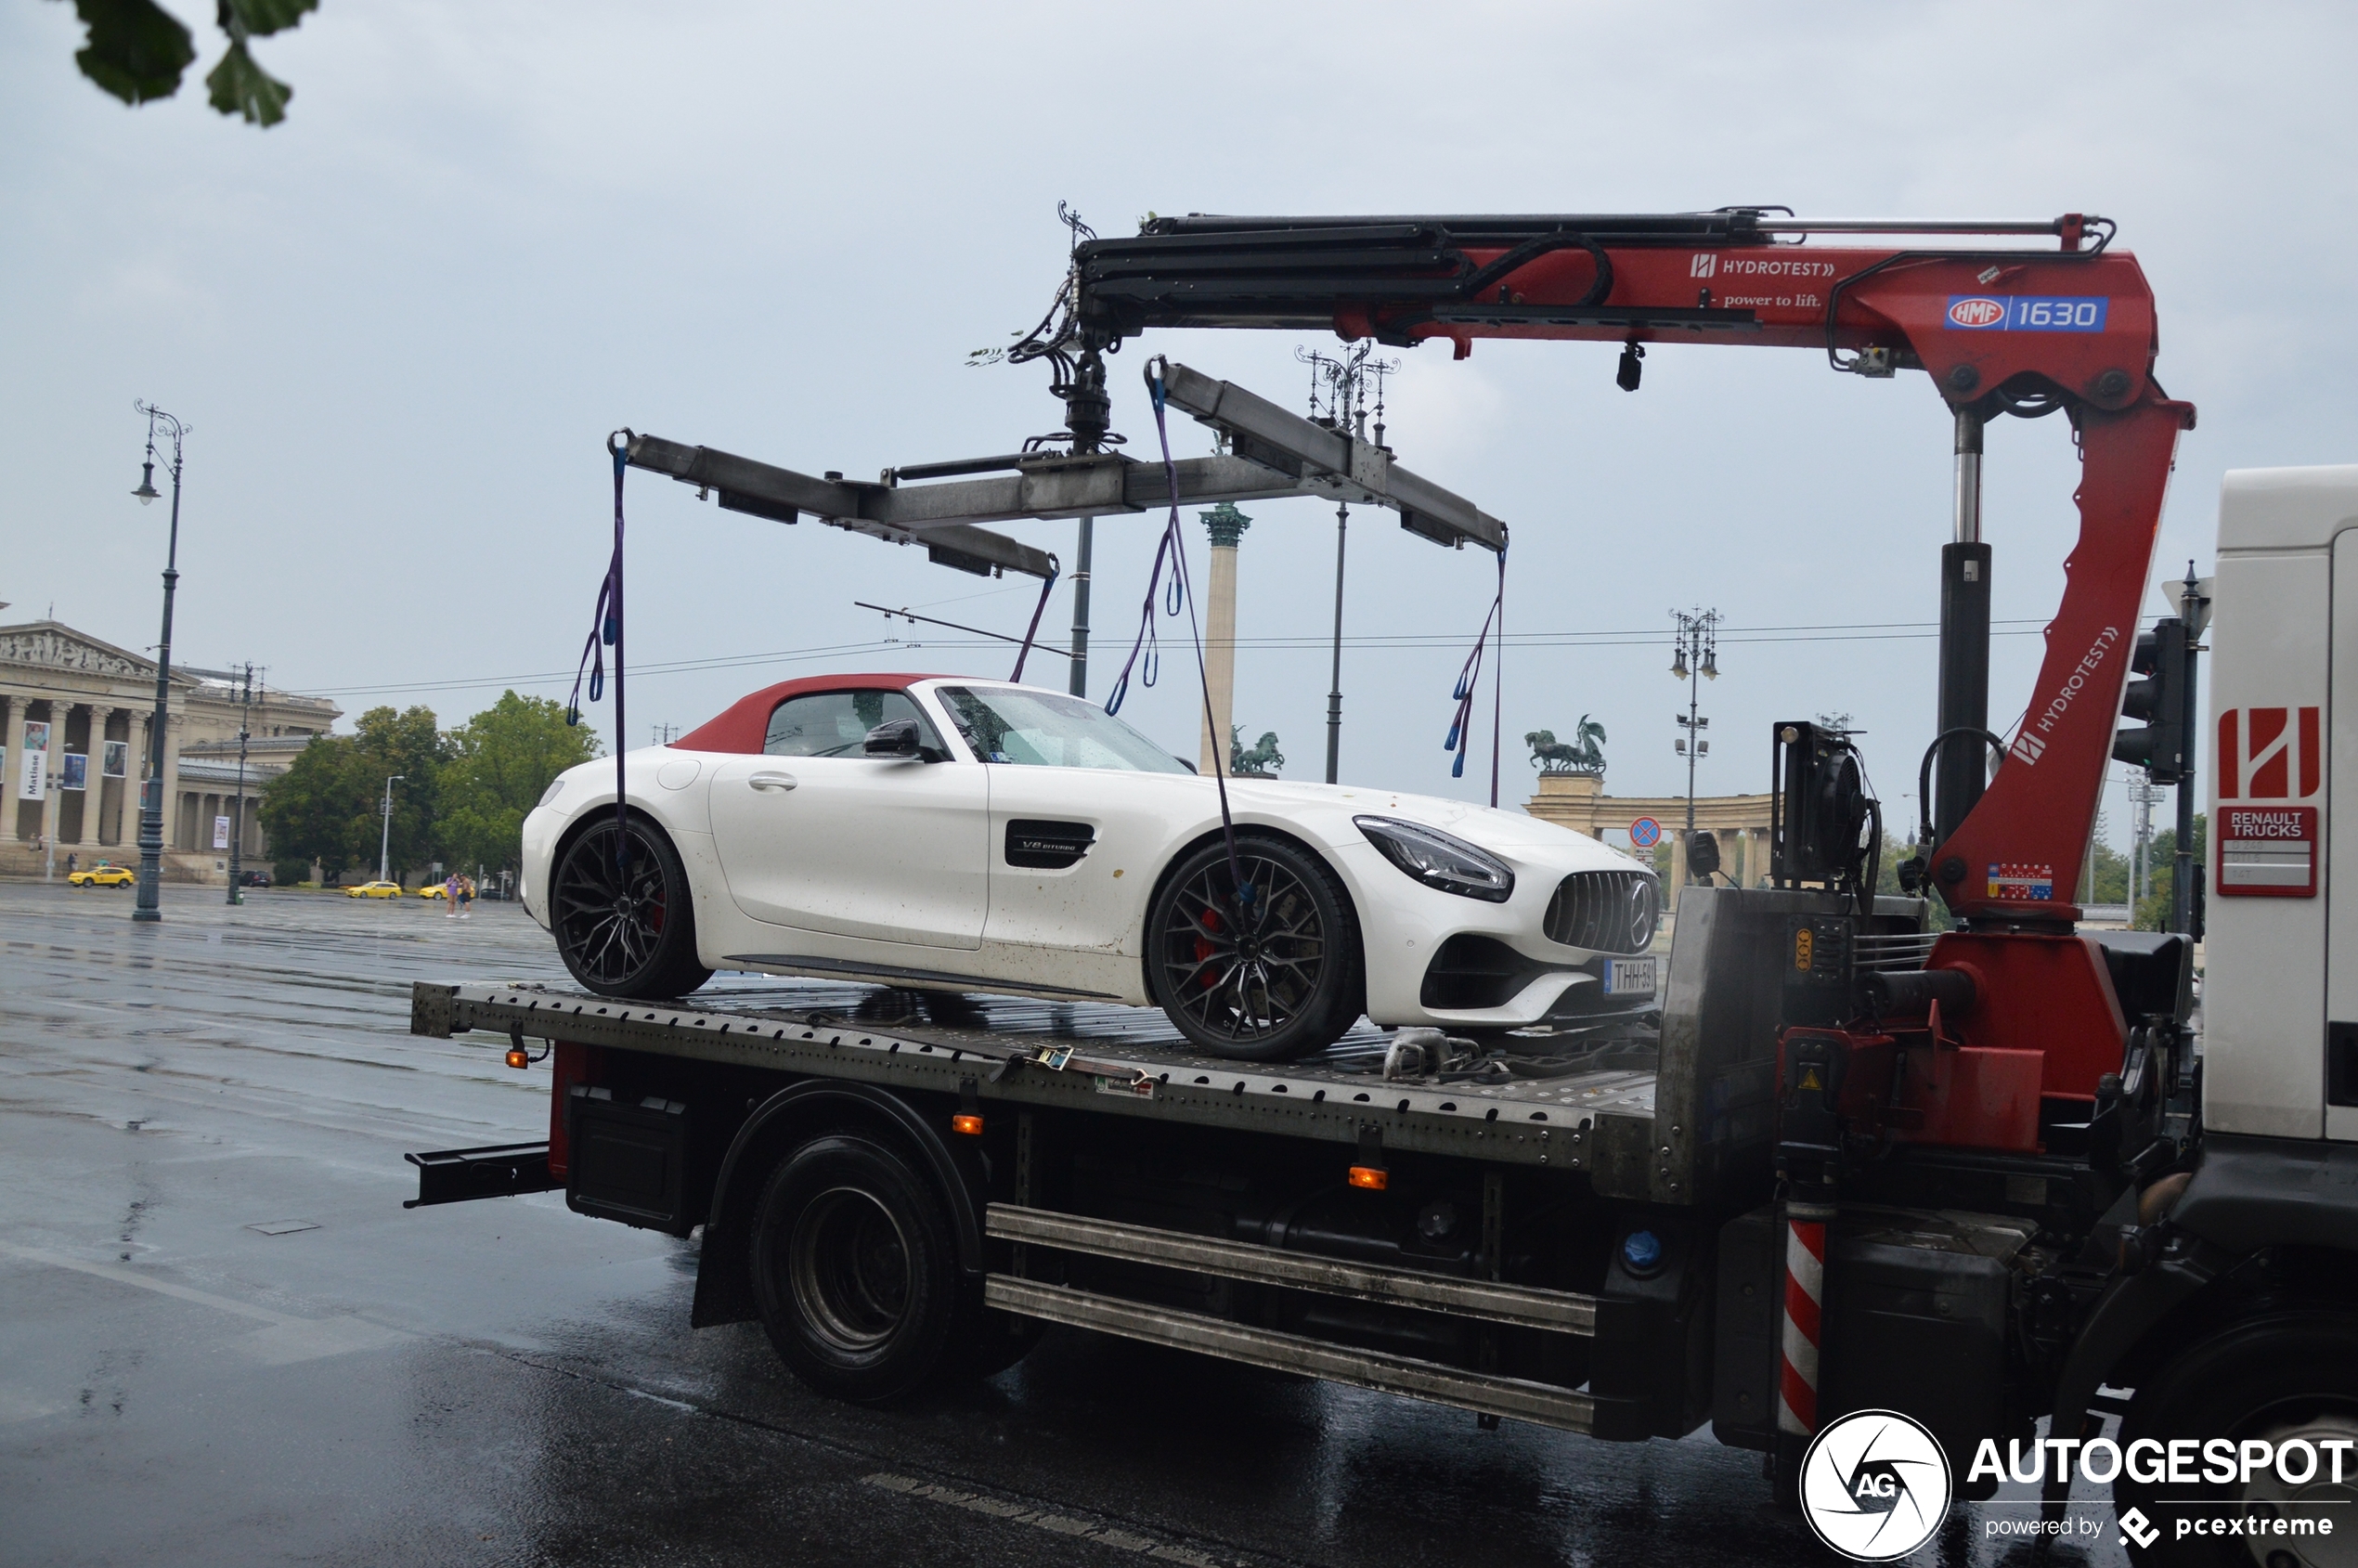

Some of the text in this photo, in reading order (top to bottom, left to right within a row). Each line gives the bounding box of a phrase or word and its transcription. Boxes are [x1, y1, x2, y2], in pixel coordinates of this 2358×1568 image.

[1724, 295, 1772, 307] power
[1776, 294, 1791, 306] to
[1794, 293, 1821, 307] lift.
[1956, 302, 1997, 323] HMF
[2019, 302, 2097, 327] 1630
[28, 755, 40, 795] Matisse
[2231, 812, 2302, 825] RENAULT
[2231, 824, 2302, 837] TRUCKS
[1022, 840, 1042, 849] V8
